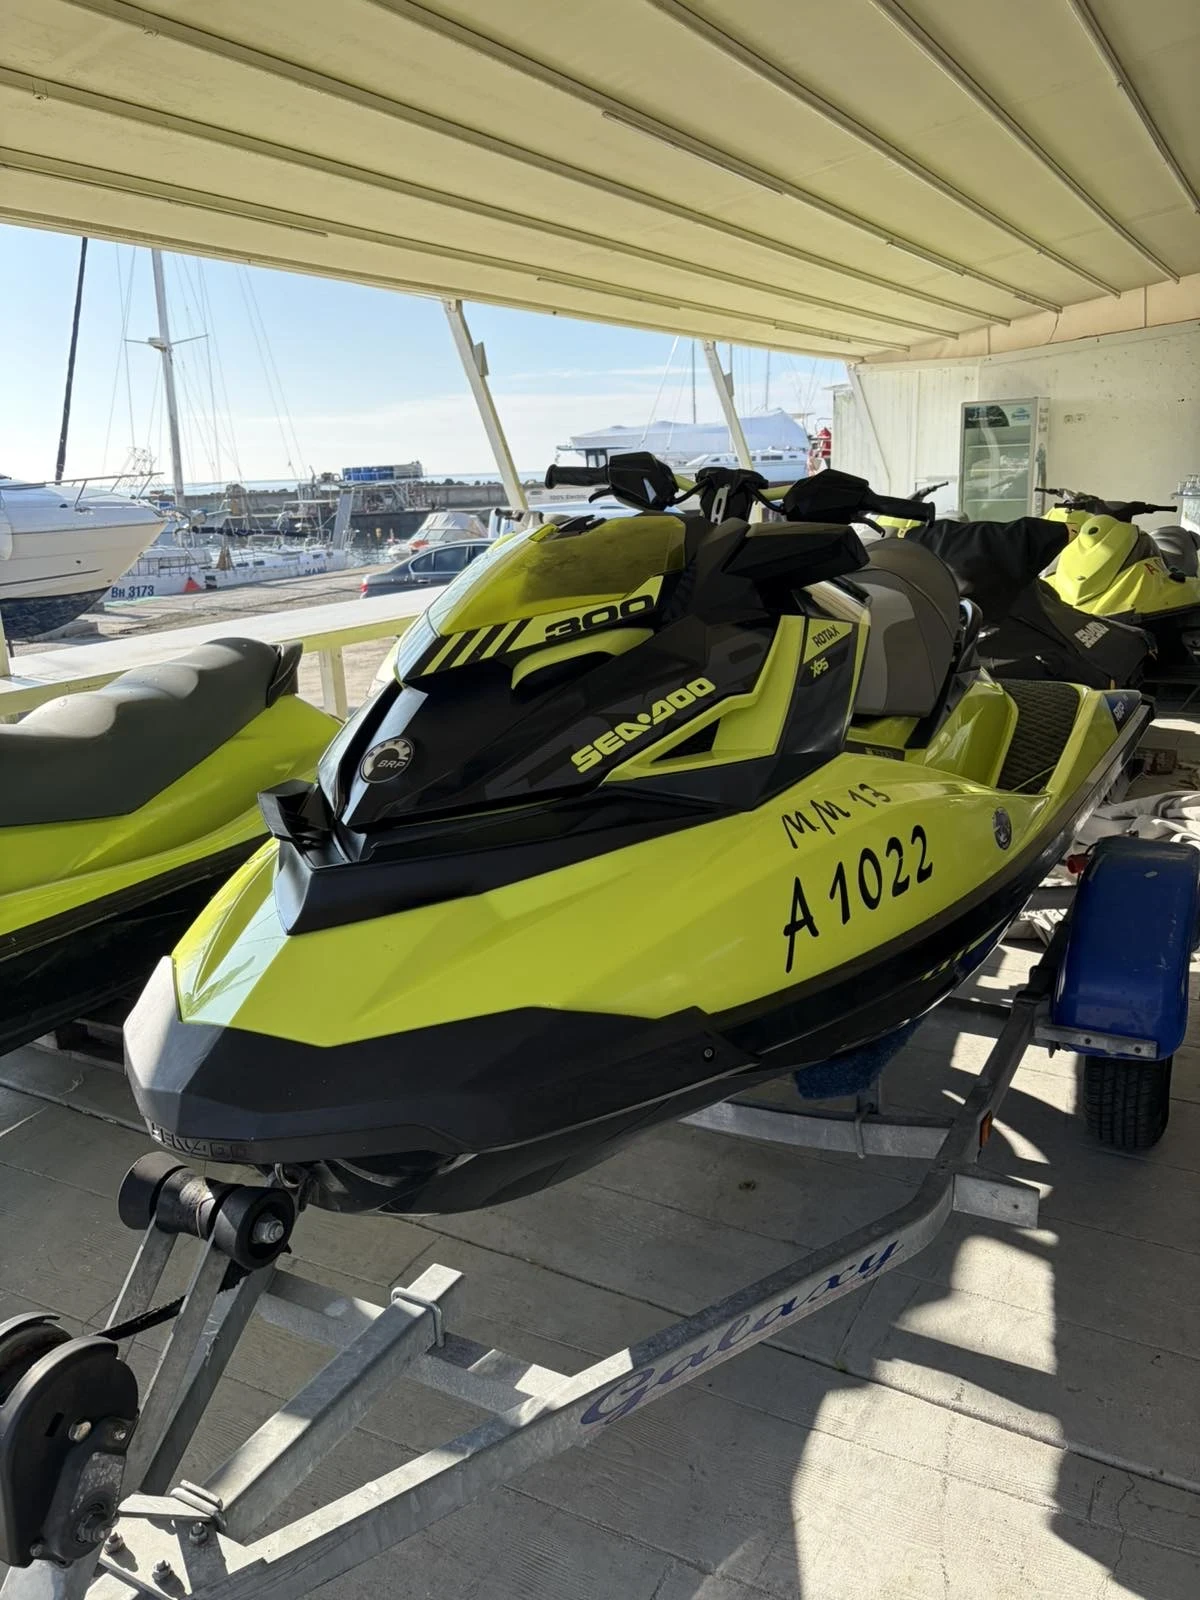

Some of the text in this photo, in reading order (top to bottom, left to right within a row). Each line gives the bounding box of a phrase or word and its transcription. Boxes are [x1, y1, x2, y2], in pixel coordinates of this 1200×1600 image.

[128, 585, 154, 598] 3173
[545, 594, 655, 641] 300
[811, 624, 841, 648] ROTAX
[810, 657, 829, 678] XPS
[376, 759, 406, 769] BRP
[847, 783, 891, 808] 13
[580, 1239, 905, 1425] Galaxy
